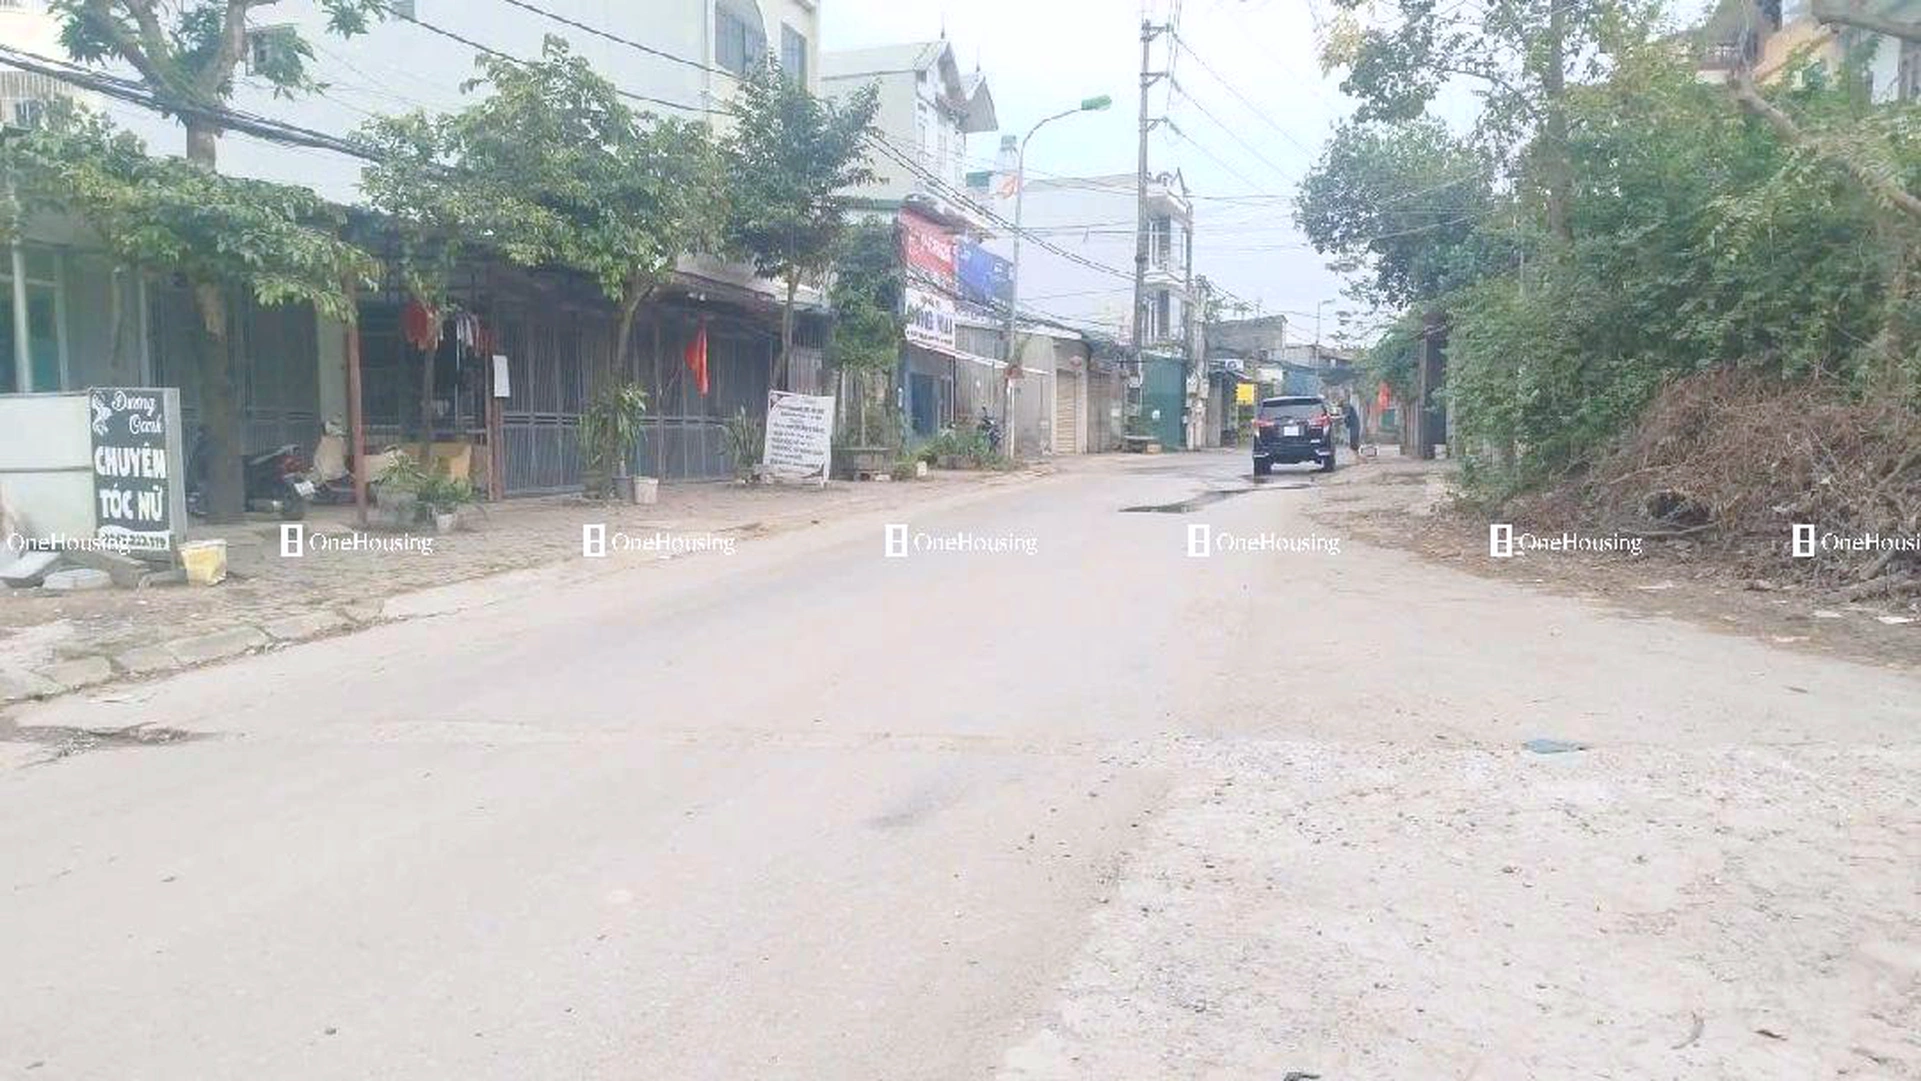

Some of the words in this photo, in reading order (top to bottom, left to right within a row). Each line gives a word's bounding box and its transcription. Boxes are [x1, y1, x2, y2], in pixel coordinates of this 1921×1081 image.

[94, 442, 166, 478] CHUYÊN
[99, 482, 134, 519] TÓC
[138, 484, 163, 521] NỮ
